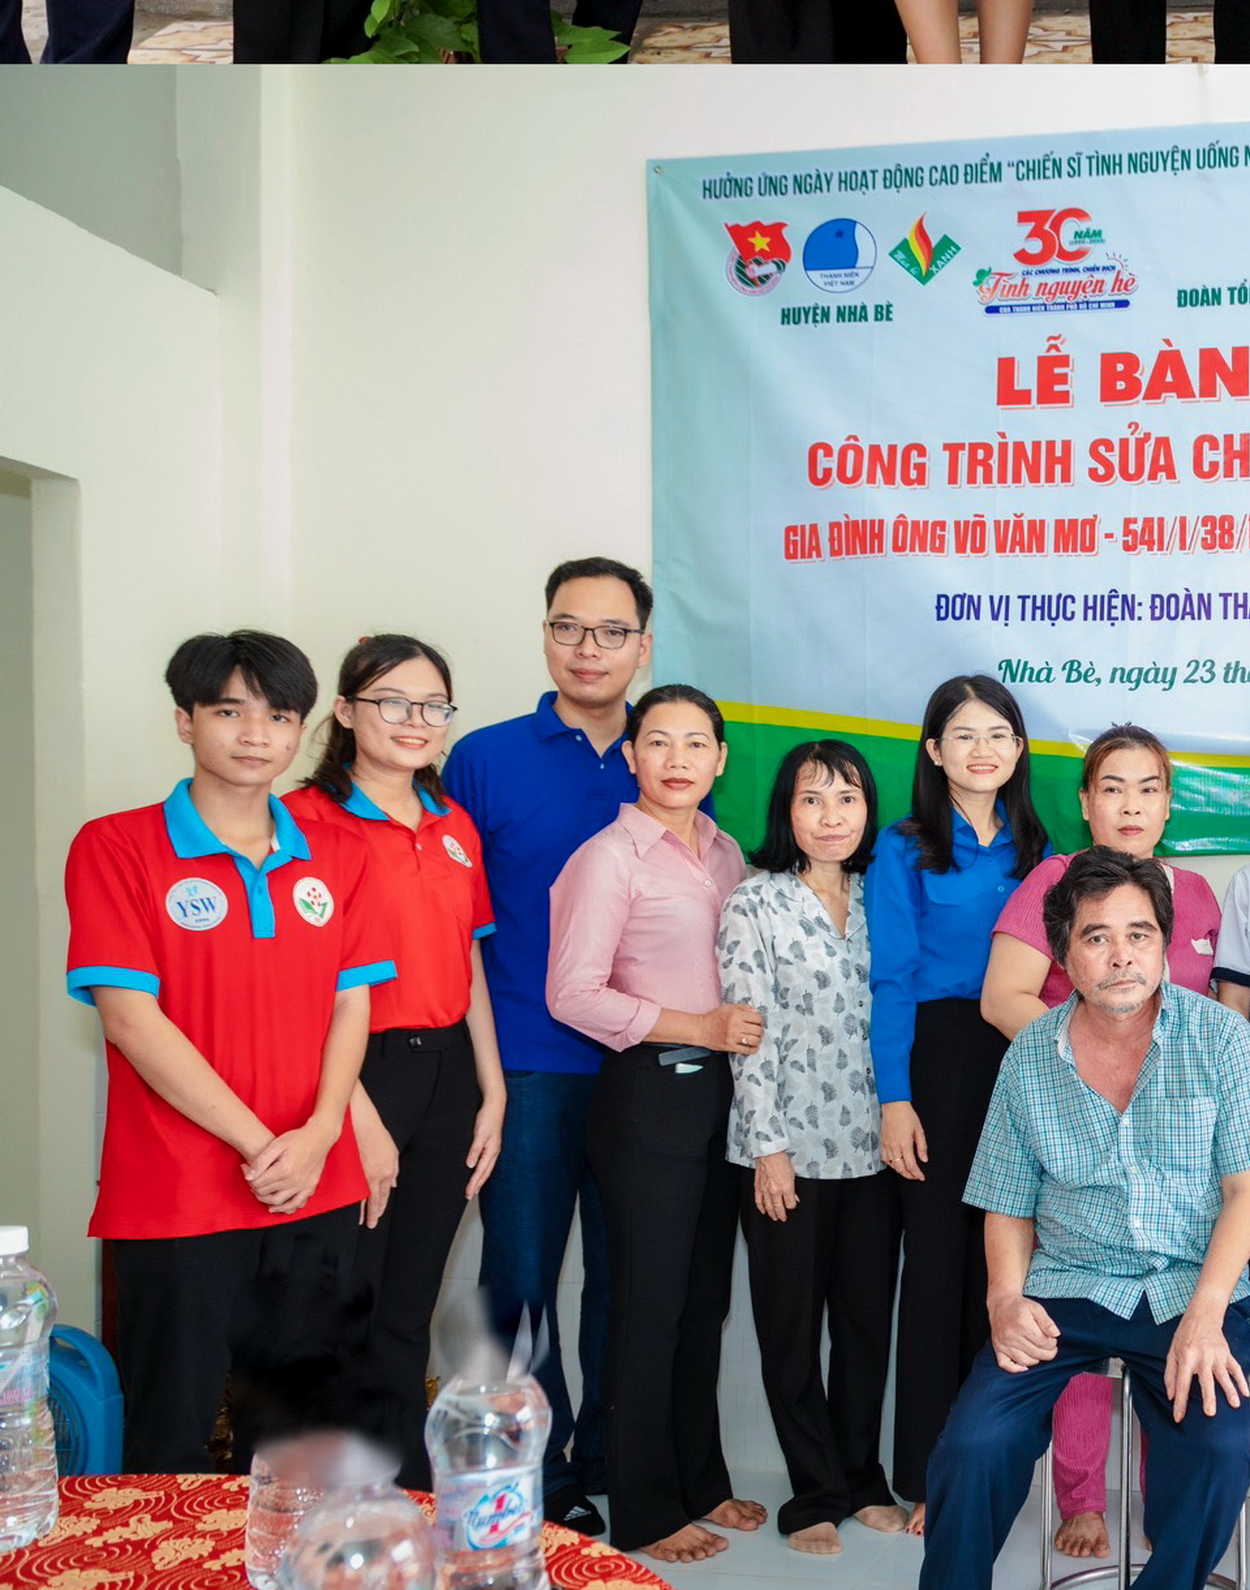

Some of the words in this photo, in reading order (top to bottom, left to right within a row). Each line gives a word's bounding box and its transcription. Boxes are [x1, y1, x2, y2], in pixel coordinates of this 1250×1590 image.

[702, 171, 753, 200] HƯỞNG
[792, 168, 834, 195] NGÀY
[838, 169, 879, 196] HOẠT
[883, 163, 924, 193] ĐỘNG
[928, 164, 960, 187] CAO
[964, 152, 1003, 184] ĐIỂM
[1067, 151, 1082, 179] SĨ
[1086, 151, 1123, 178] TÌNH
[1127, 145, 1191, 177] NGUYỆN
[1196, 141, 1240, 170] UỐNG
[1074, 228, 1102, 240] NĂM
[978, 272, 1031, 303] Tình
[1035, 274, 1105, 302] nguyện
[1110, 269, 1136, 294] hè
[1177, 284, 1222, 308] ĐOÀN
[781, 303, 831, 328] HUYỆN
[836, 301, 868, 324] NHÀ
[874, 300, 894, 322] BÈ
[996, 334, 1074, 409] LỄ
[807, 434, 930, 488] CÔNG
[942, 431, 1076, 488] TRÌNH
[1088, 421, 1179, 486] SỬA
[783, 522, 824, 563] GIA
[828, 514, 887, 560] ĐÌNH
[891, 513, 949, 558] ÔNG
[953, 512, 990, 557] VÕ
[993, 513, 1046, 556] VĂN
[1053, 513, 1101, 556] MƠ
[935, 593, 982, 622] ĐƠN
[989, 594, 1011, 628] VỊ
[1018, 592, 1077, 626] THỰC
[1082, 588, 1143, 628] HIỆN:
[1149, 585, 1212, 621] ĐOÀN
[997, 657, 1056, 687] Nhà
[1061, 656, 1102, 687] Bè,
[1108, 659, 1177, 692] ngày
[1183, 658, 1217, 685] 23
[177, 897, 218, 918] YSW
